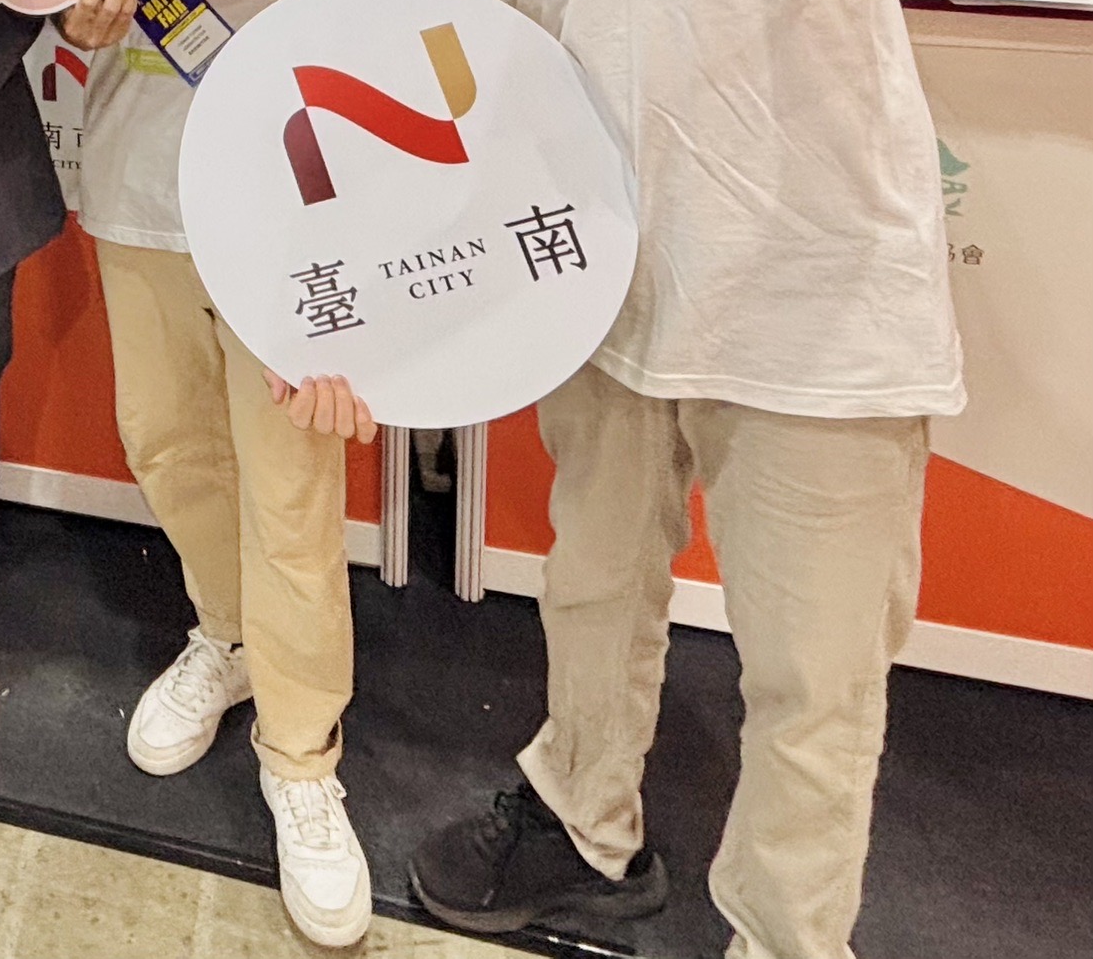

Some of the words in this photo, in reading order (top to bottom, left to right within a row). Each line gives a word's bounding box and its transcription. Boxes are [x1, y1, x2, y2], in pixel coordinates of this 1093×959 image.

[378, 237, 487, 280] TAINAN
[503, 203, 588, 282] 南
[289, 258, 366, 339] 臺
[408, 268, 476, 300] CITY
